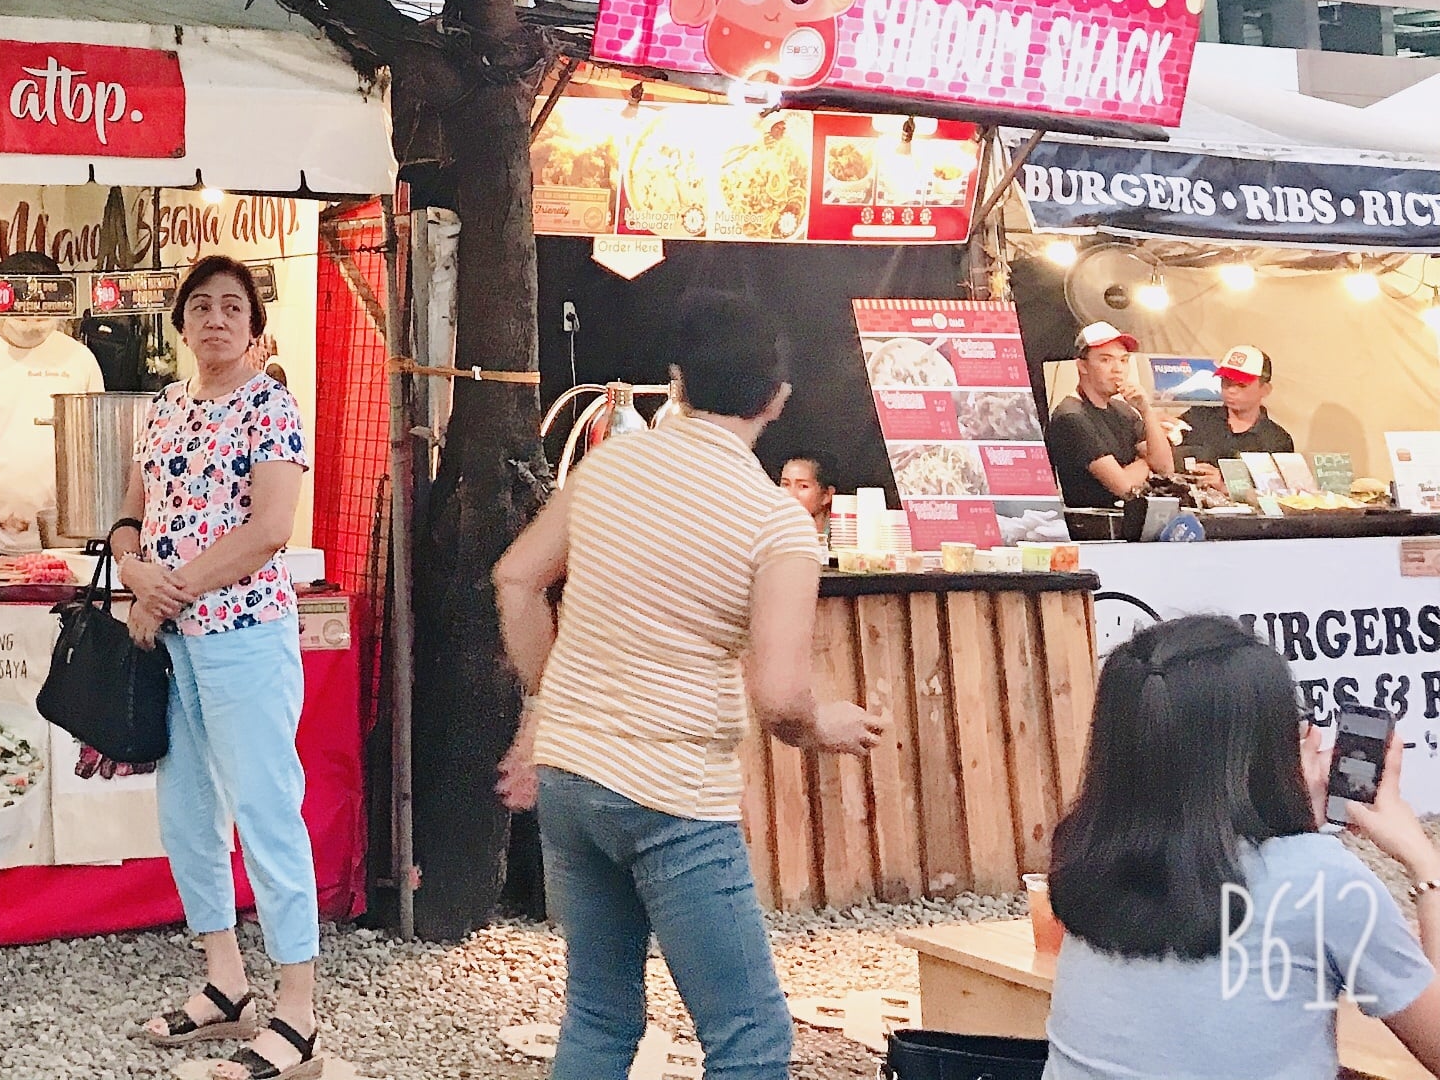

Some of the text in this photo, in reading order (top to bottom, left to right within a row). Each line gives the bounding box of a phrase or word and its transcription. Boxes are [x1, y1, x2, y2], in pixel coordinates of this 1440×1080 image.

[1043, 16, 1173, 104] SHACK
[10, 56, 144, 145] atbp.
[1024, 164, 1217, 216] BURGERS
[1240, 185, 1336, 225] RIBS
[598, 240, 659, 253] Order Here
[714, 223, 743, 235] Pasta
